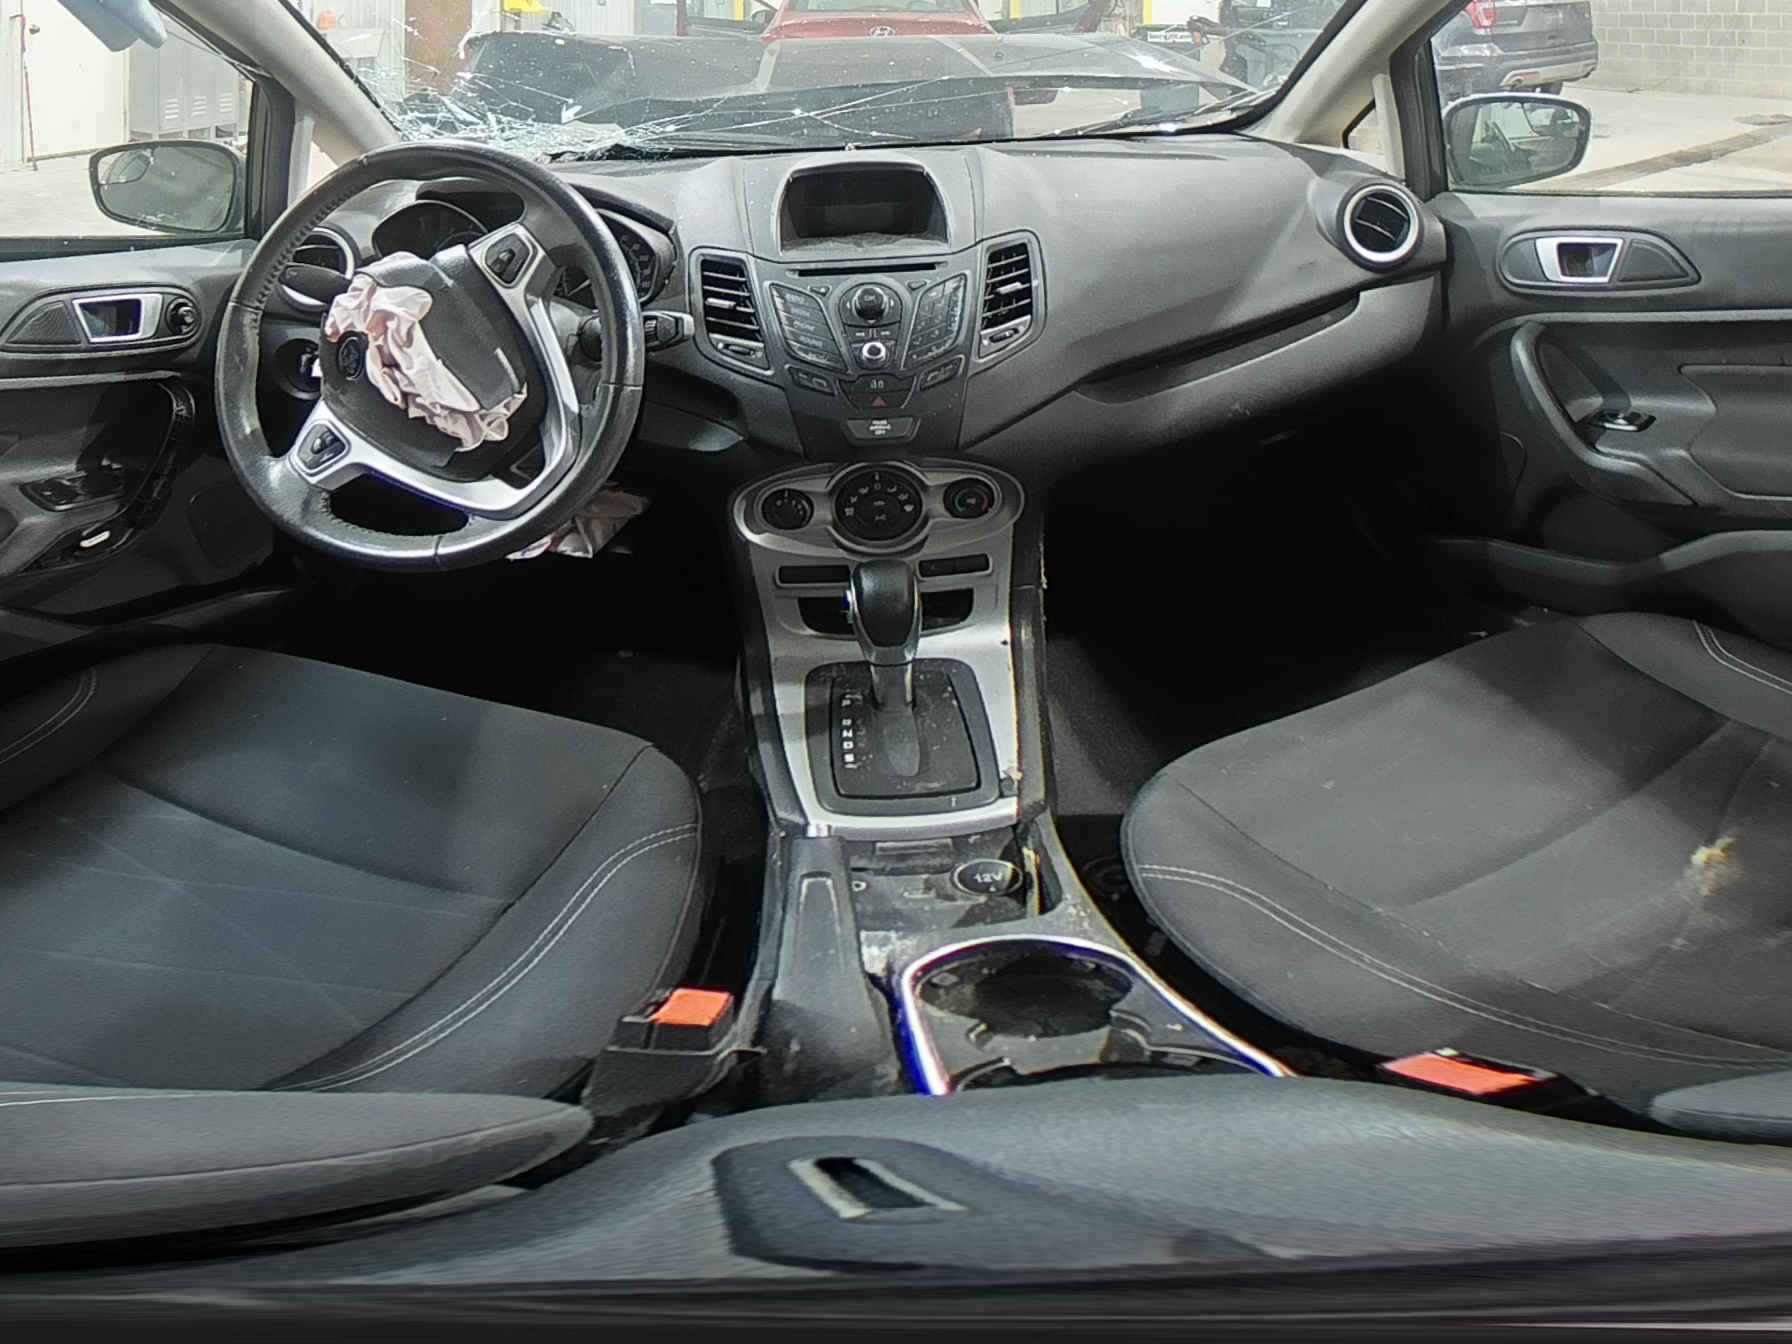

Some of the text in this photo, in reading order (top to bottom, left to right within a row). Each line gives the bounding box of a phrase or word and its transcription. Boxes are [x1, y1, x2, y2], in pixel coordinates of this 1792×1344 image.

[842, 729, 853, 737] N
[843, 741, 854, 749] D
[973, 872, 1003, 883] 12V
